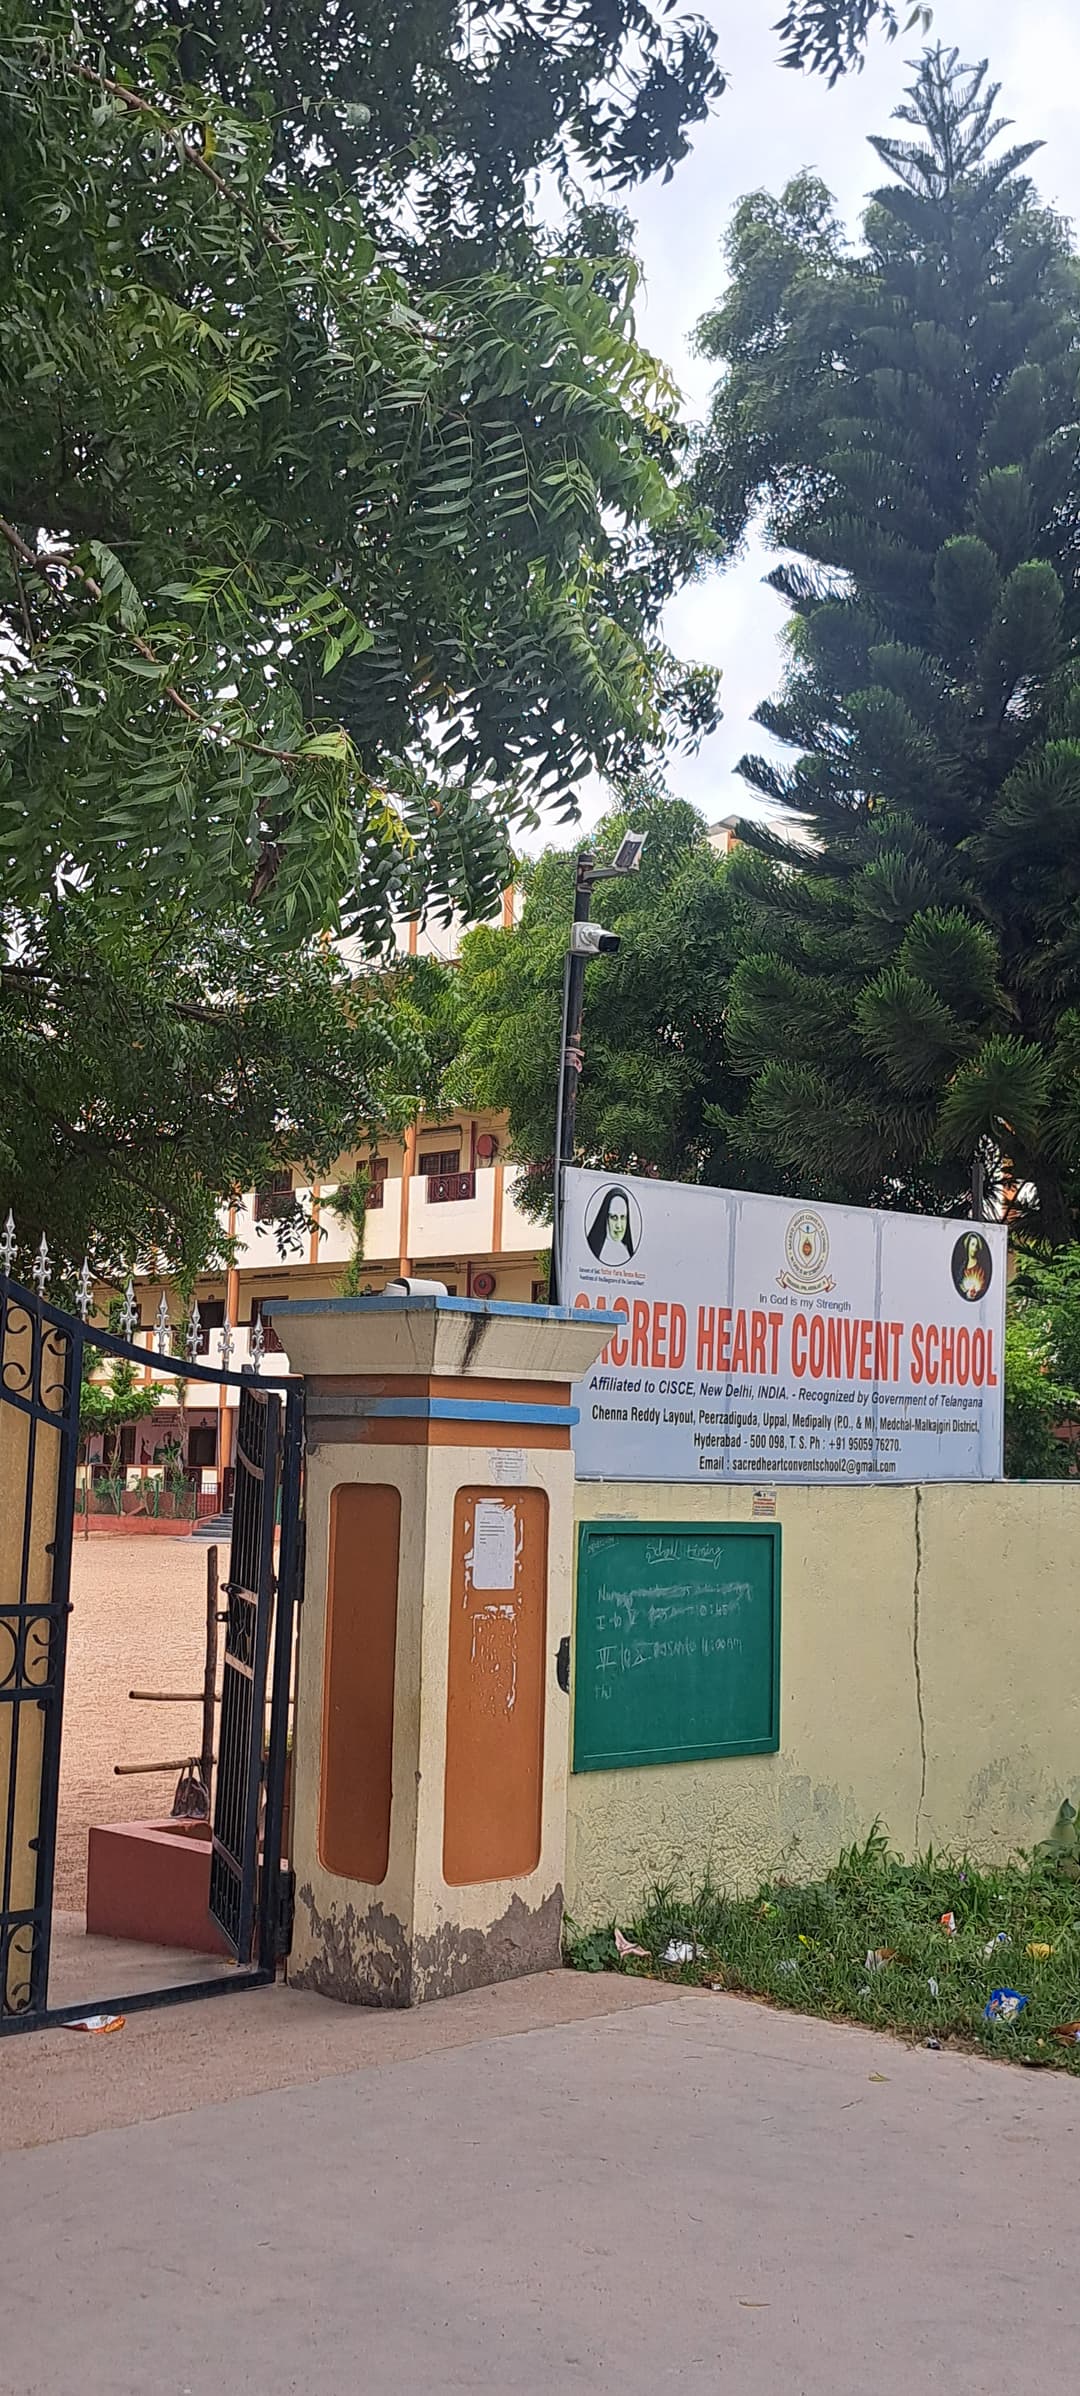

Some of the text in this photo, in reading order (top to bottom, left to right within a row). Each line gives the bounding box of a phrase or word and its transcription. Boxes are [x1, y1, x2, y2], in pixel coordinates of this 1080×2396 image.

[760, 1294, 851, 1312] In God is my Strength
[574, 1292, 997, 1386] CRED HEART CONVENT SCHOOL
[589, 1376, 642, 1393] Affiliated
[644, 1380, 655, 1394] to
[659, 1380, 696, 1398] CISCE,
[699, 1382, 723, 1398] New
[726, 1383, 755, 1400] Delhi,
[757, 1386, 789, 1400] INDIA.
[798, 1388, 854, 1405] Recognized
[857, 1390, 869, 1406] by
[871, 1392, 926, 1407] Government
[928, 1393, 938, 1407] of
[940, 1394, 983, 1410] Telangana
[592, 1404, 628, 1421] Chenna
[631, 1407, 660, 1425] Reddy
[663, 1408, 696, 1426] Layout,
[699, 1409, 760, 1428] Peerzadiguda,
[763, 1412, 789, 1429] Uppal,
[792, 1413, 831, 1430] Medipally
[856, 1416, 862, 1429] &
[879, 1417, 951, 1434] Medchal-Malkajgiri
[952, 1419, 980, 1434] District,
[694, 1432, 742, 1450] Hyderabad
[750, 1435, 767, 1448] 500
[768, 1435, 787, 1450] 098,
[790, 1436, 796, 1449] T.
[798, 1436, 807, 1449] S.
[809, 1436, 820, 1449] Ph
[829, 1437, 846, 1450] +91
[848, 1438, 873, 1451] 95059
[875, 1438, 901, 1452] 76270.
[699, 1456, 724, 1470] Email
[732, 1457, 896, 1474] sacredheartconventschool2@gmail.com
